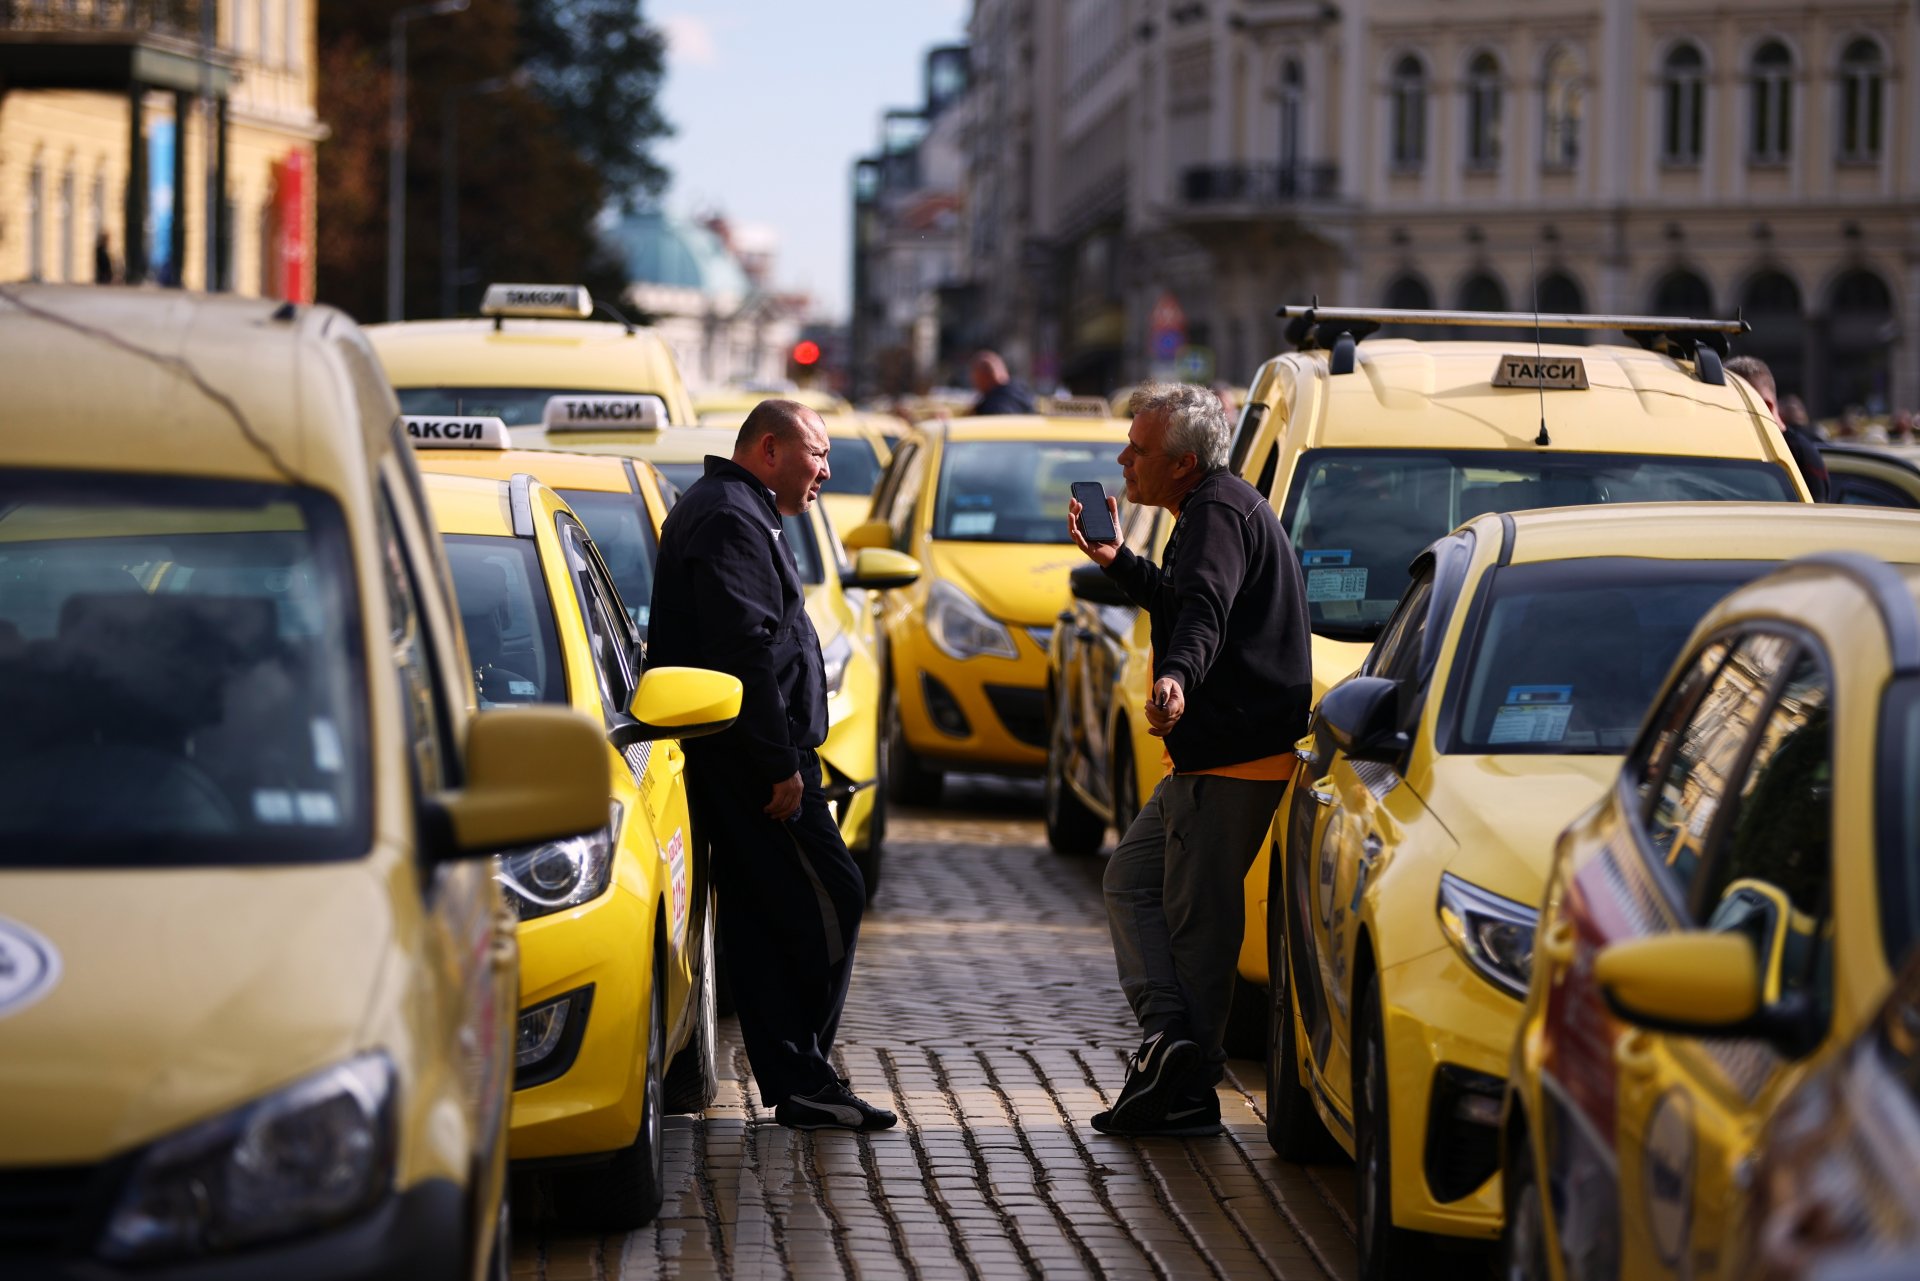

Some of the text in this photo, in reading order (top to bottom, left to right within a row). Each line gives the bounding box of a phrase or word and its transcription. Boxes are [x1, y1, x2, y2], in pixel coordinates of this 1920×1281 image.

[1507, 363, 1576, 380] ТАКСИ
[566, 402, 642, 420] ТАКСИ
[407, 421, 484, 440] АКСИ
